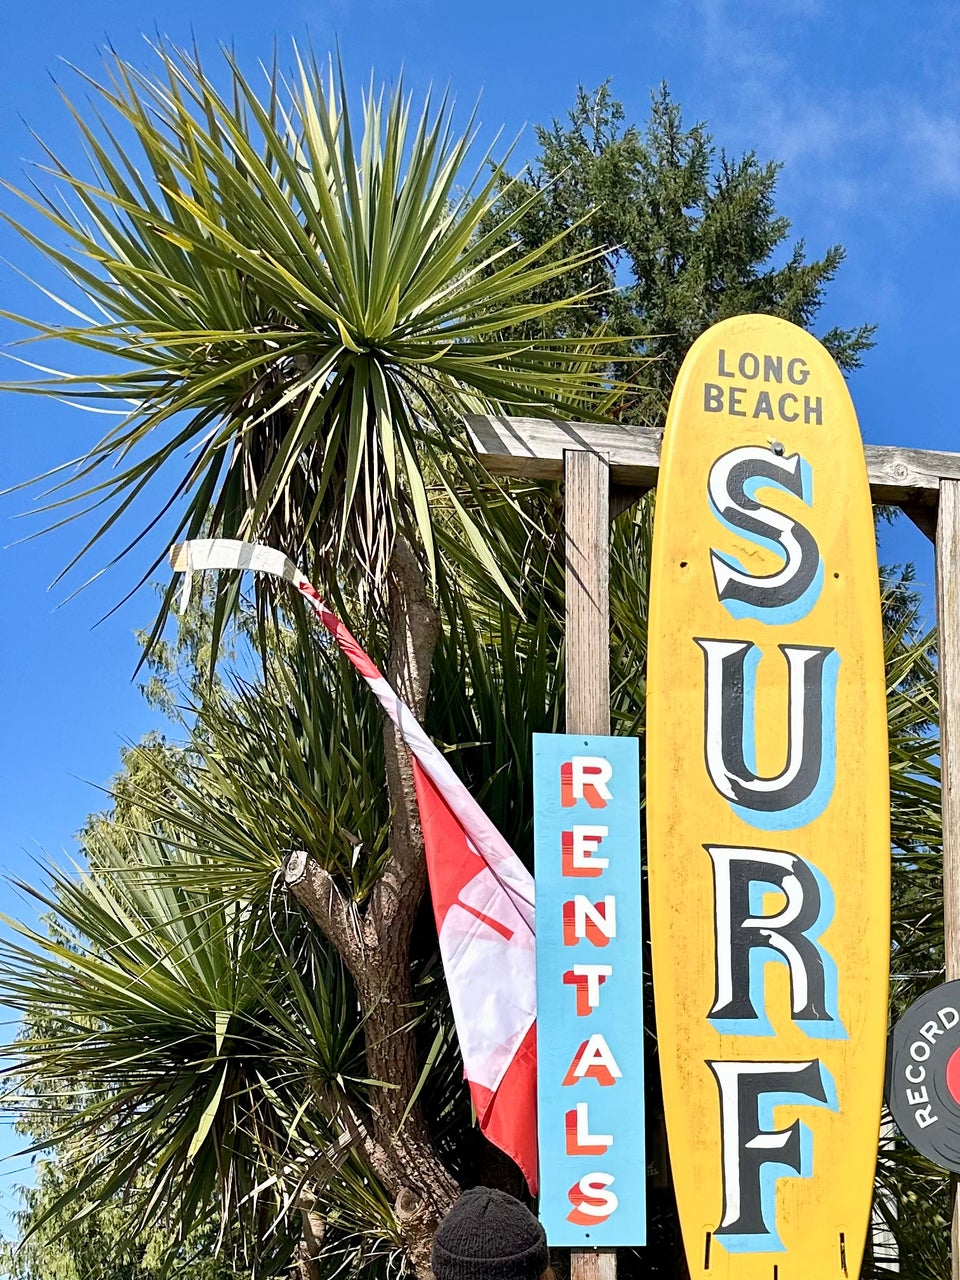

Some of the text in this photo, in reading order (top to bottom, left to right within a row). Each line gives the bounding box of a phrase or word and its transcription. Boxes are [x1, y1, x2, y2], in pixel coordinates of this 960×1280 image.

[704, 383, 823, 425] BEACH
[718, 349, 810, 385] LONG
[694, 445, 850, 1253] SURF
[561, 756, 622, 1226] RENTALS
